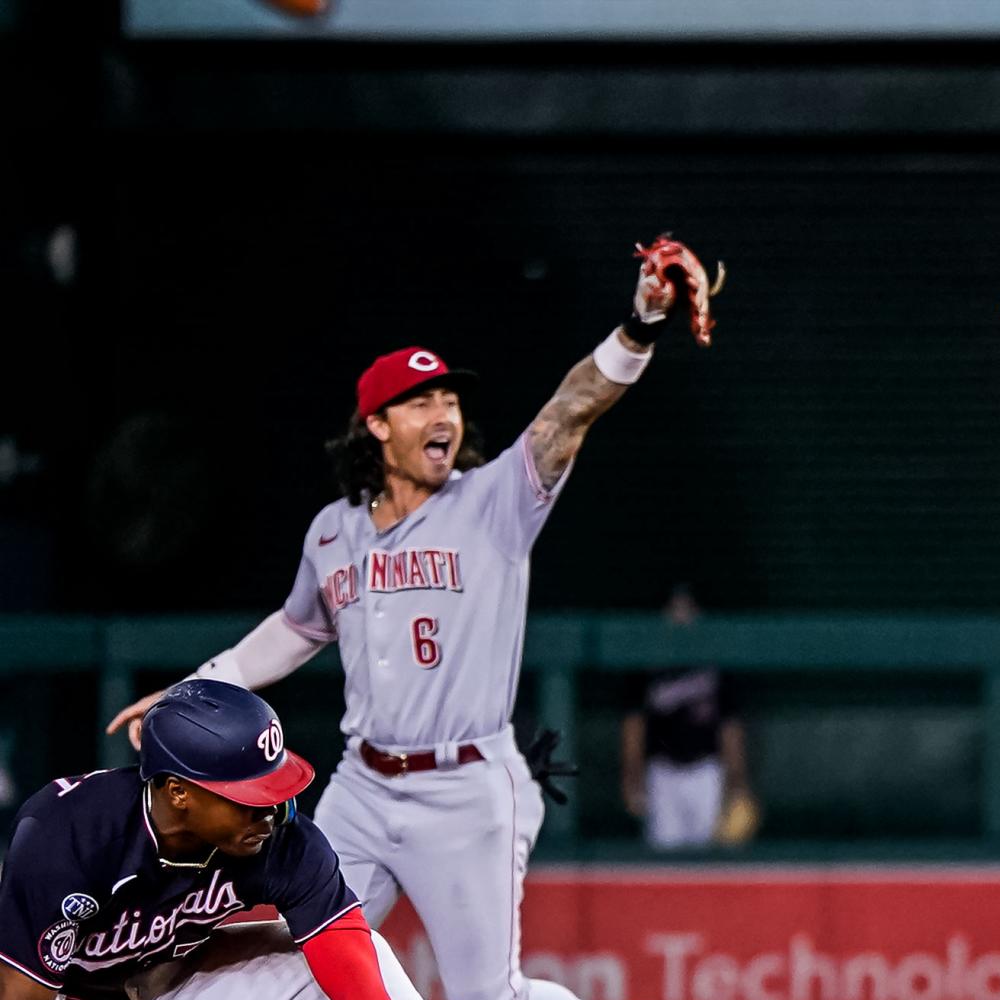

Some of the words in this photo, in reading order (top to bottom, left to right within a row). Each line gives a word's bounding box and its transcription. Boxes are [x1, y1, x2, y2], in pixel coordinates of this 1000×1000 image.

[410, 614, 442, 670] 6
[257, 718, 284, 762] W
[74, 869, 245, 958] atioals
